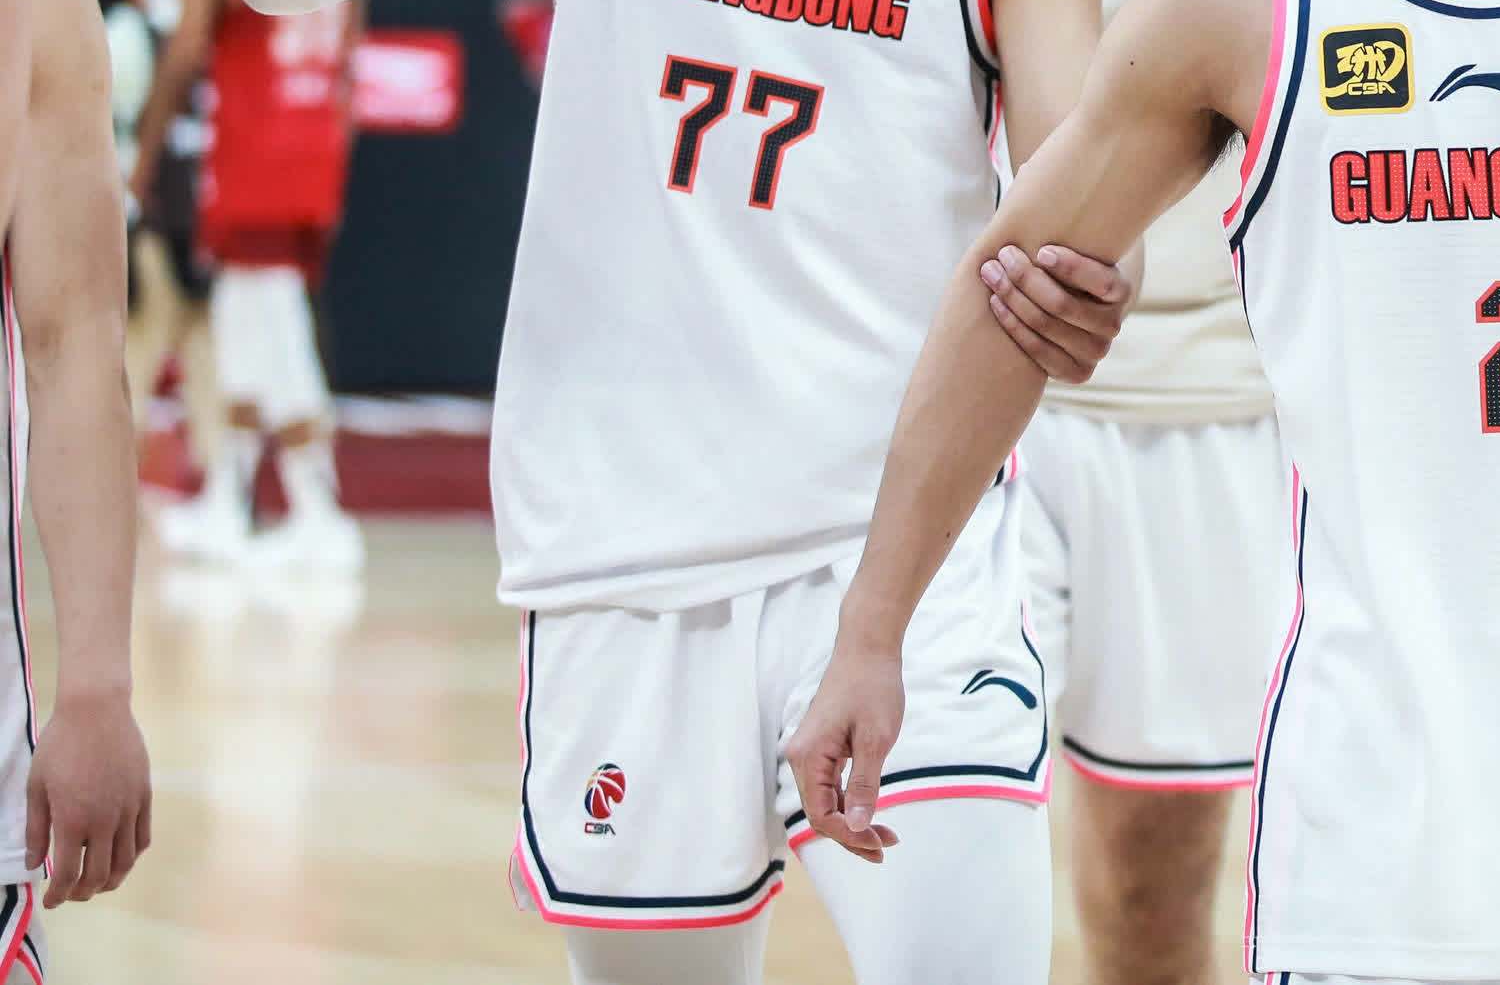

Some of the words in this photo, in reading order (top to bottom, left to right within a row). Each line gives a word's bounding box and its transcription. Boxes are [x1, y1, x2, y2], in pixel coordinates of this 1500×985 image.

[1347, 82, 1397, 96] CBA
[659, 54, 825, 211] 77
[584, 822, 616, 836] CBA
